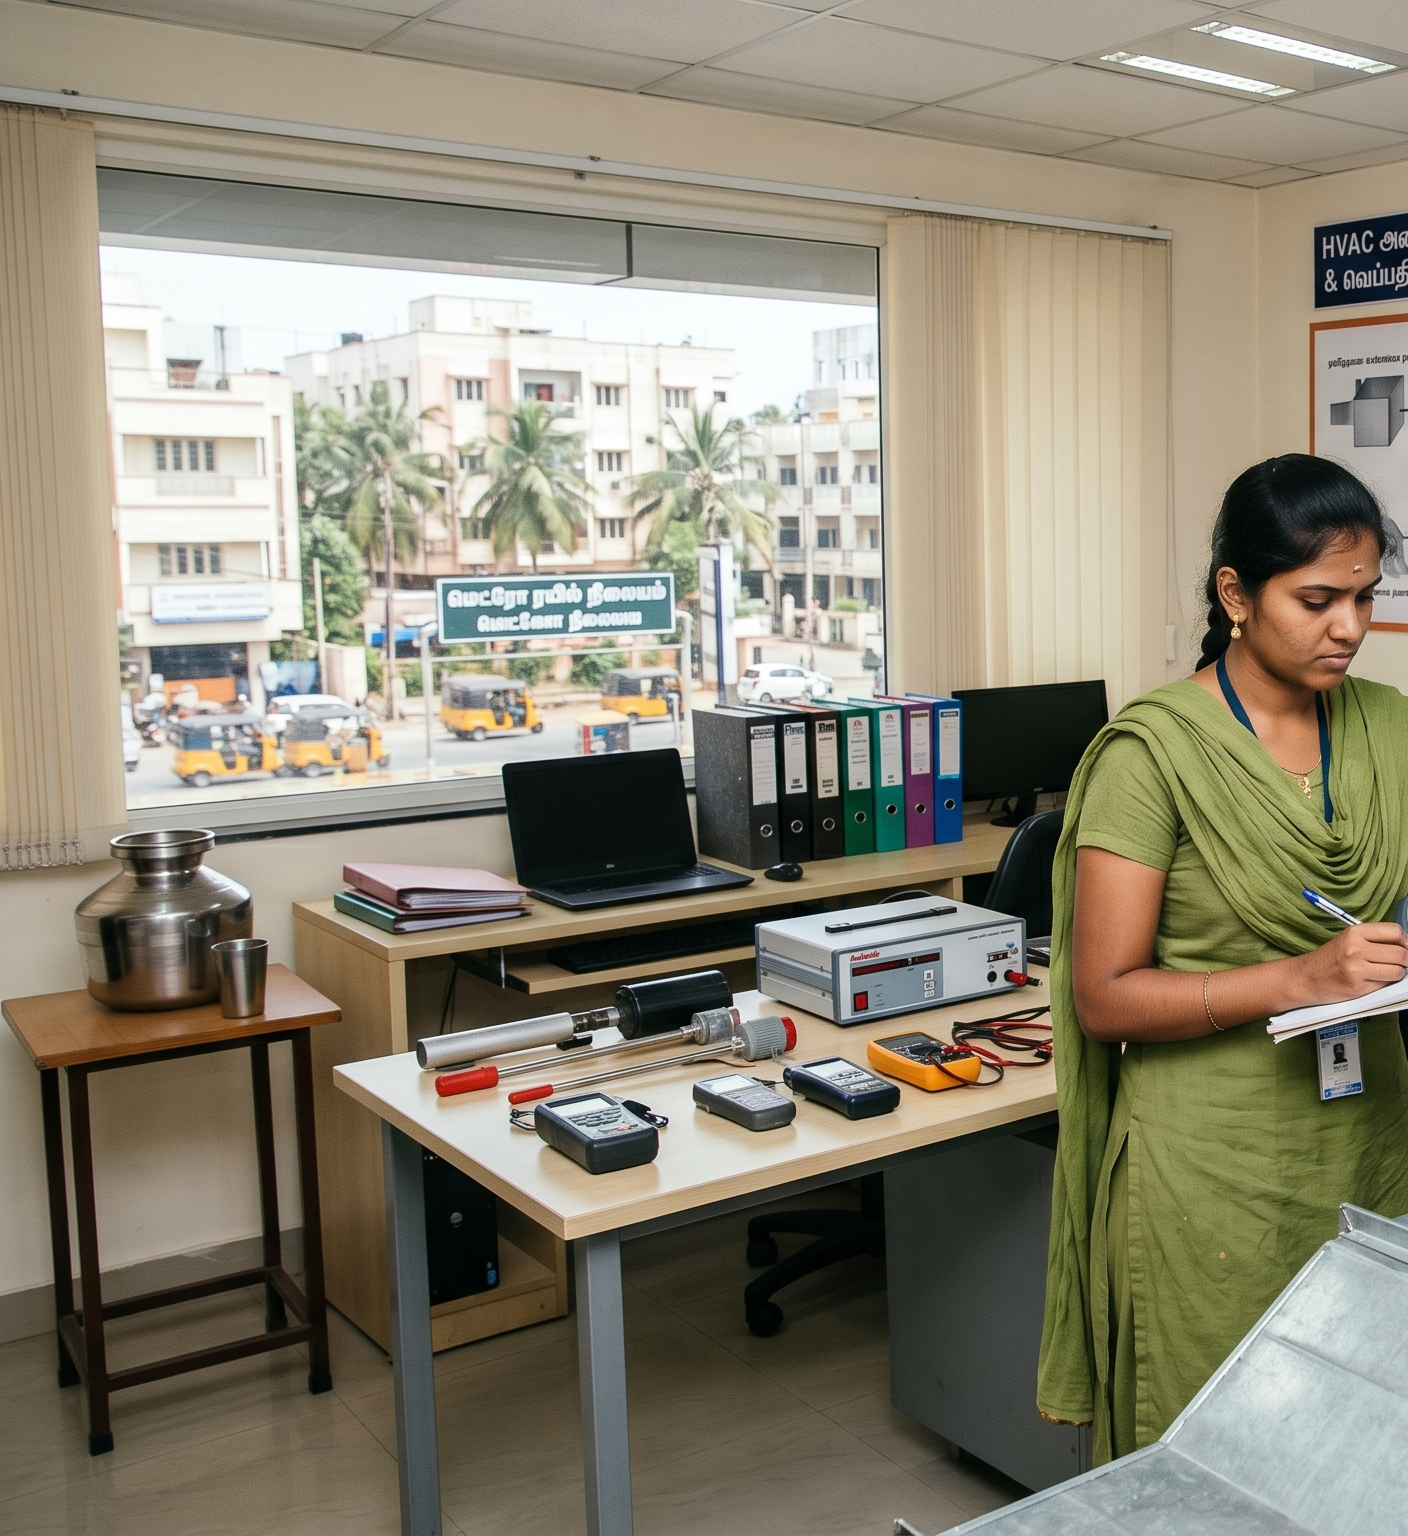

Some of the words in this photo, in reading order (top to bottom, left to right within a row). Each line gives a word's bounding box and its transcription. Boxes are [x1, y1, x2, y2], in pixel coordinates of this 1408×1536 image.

[1322, 230, 1374, 260] HVAC
[1324, 268, 1338, 293] &
[447, 586, 529, 611] மெட்ரோ
[532, 582, 583, 610] ரயில்
[586, 580, 667, 608] நிலையம்
